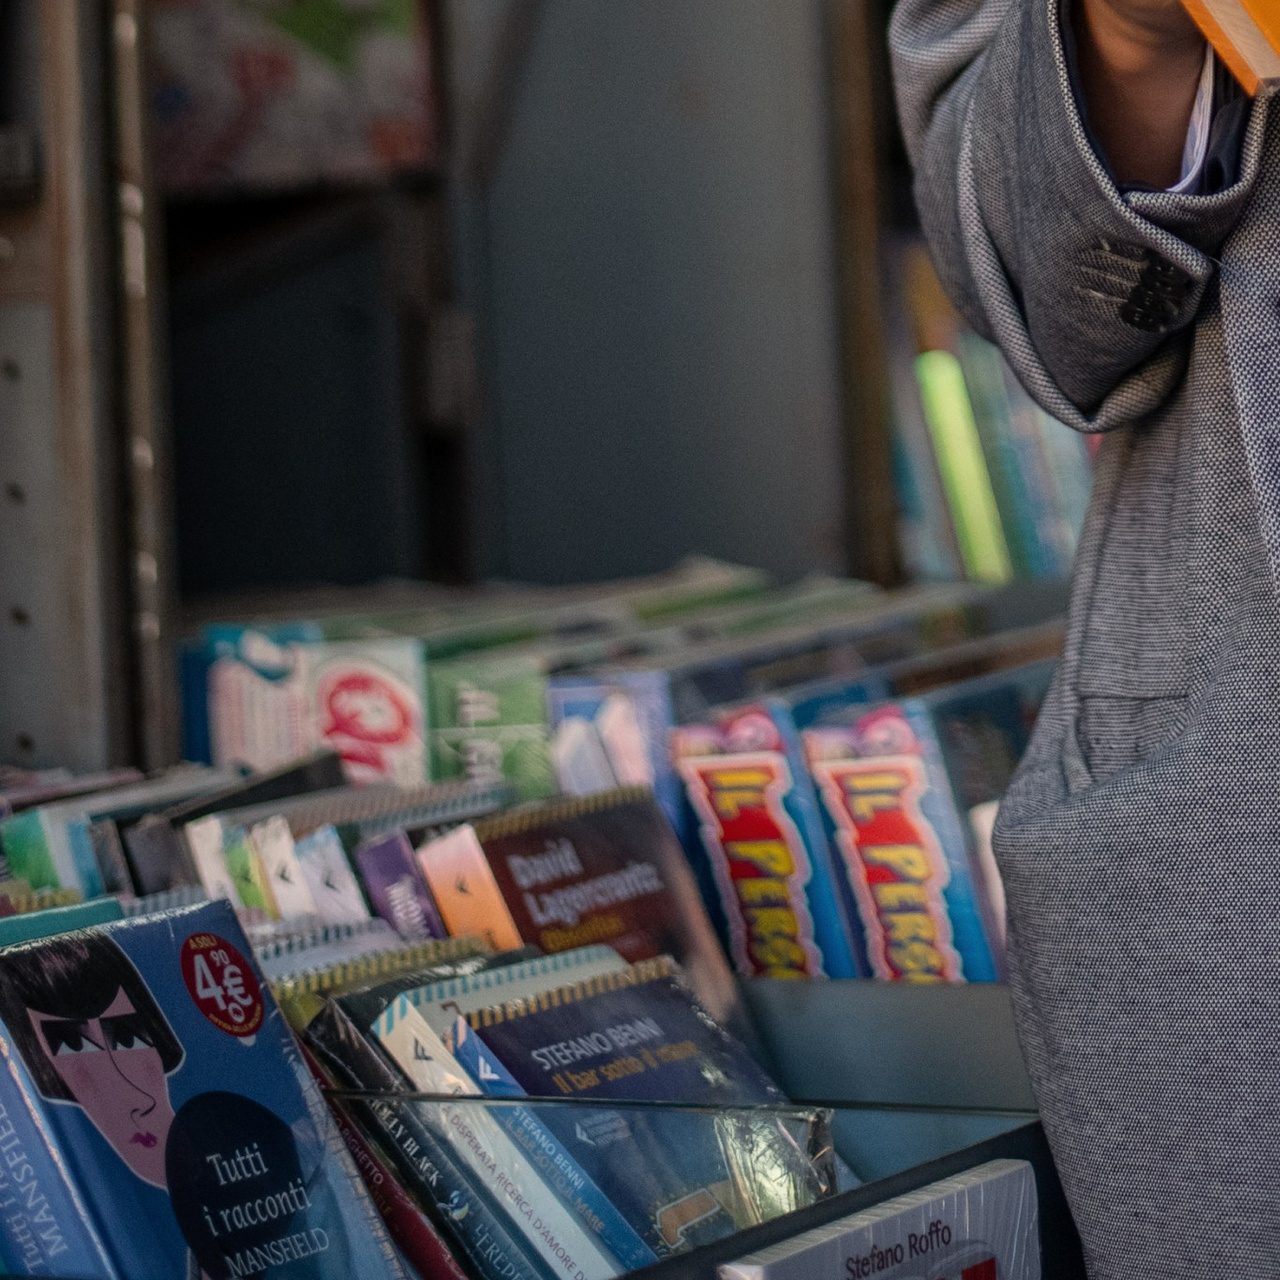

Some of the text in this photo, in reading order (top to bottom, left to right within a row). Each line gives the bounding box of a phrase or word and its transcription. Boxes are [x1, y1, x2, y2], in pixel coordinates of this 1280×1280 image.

[710, 769, 773, 820] IL
[845, 773, 908, 824] IL
[508, 839, 584, 889] David
[531, 1016, 665, 1072] STEFANO BENNI
[571, 1062, 602, 1089] bar
[602, 1052, 647, 1082] sotto
[206, 1142, 270, 1188] Tutti
[342, 1127, 385, 1185] RIGHETTO
[402, 1137, 444, 1188] BLACK
[513, 1106, 586, 1189] STEFANO BENNI
[203, 1178, 313, 1237] i racconti
[451, 1114, 498, 1175] DISPERATA
[497, 1172, 534, 1220] RICERCA
[532, 1218, 577, 1272] D'AMORE
[6, 1212, 45, 1276] Tutti
[224, 1227, 331, 1279] MANSFIELD
[845, 1219, 953, 1280] Stefano Roffo
